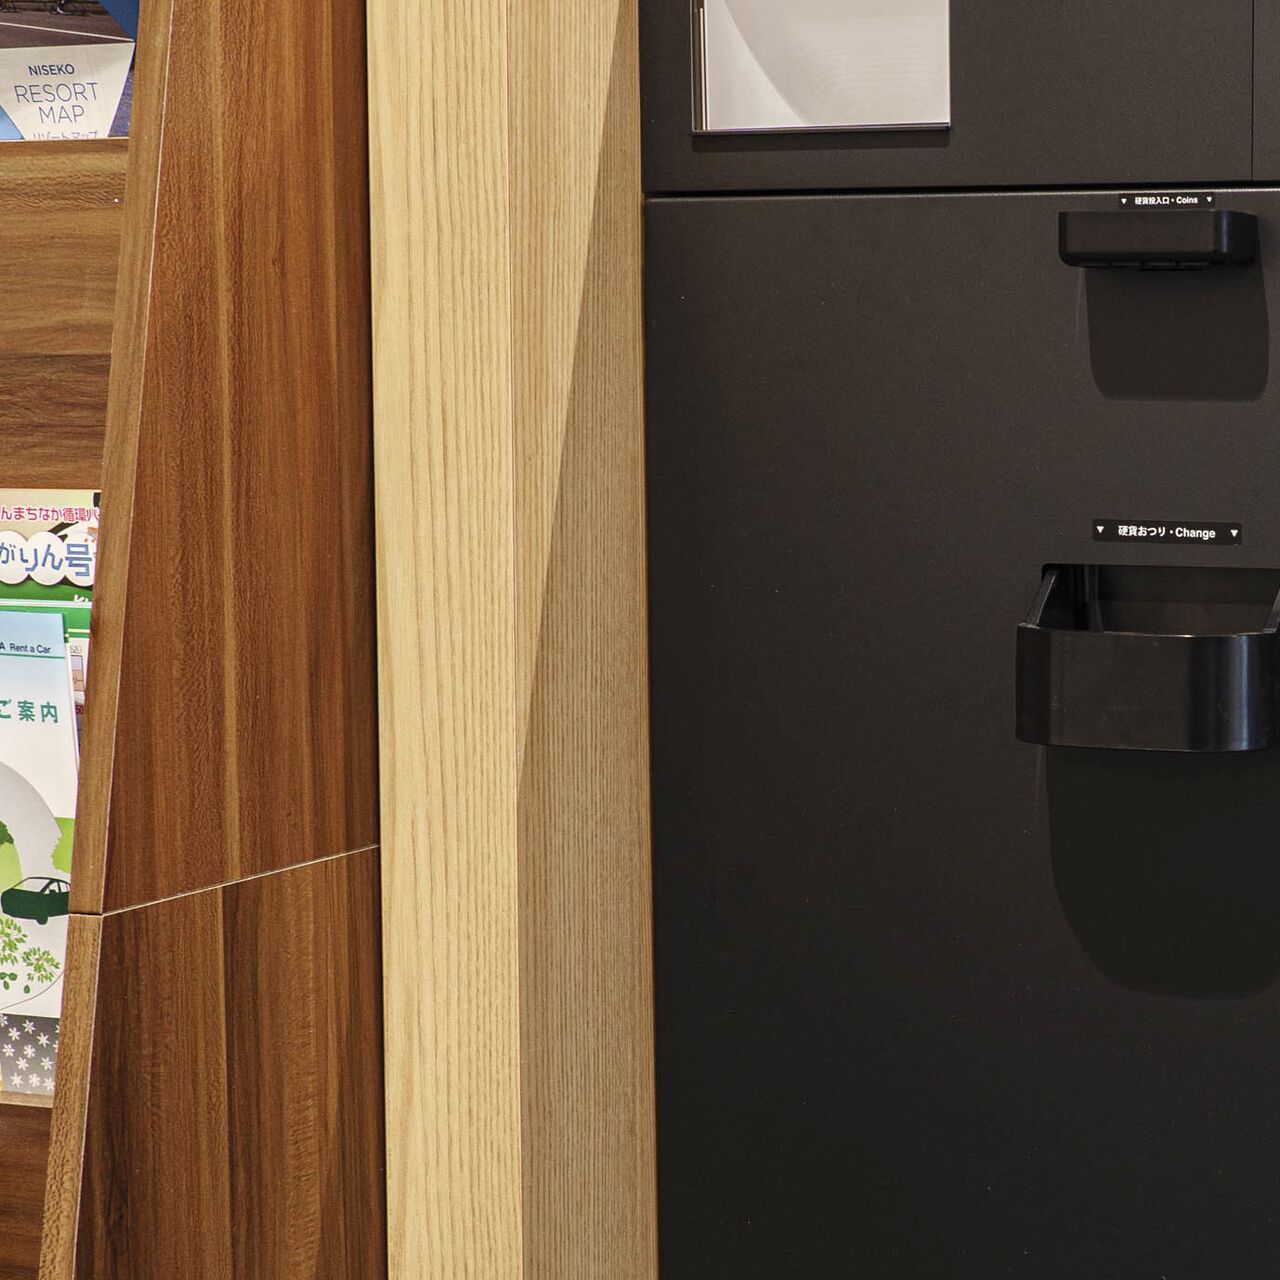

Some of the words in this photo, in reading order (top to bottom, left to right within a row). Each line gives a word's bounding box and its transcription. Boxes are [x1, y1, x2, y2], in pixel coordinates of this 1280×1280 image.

[28, 63, 75, 76] NISEKO
[14, 82, 98, 103] RESORT
[38, 105, 85, 124] MAP
[1118, 525, 1216, 540] 硬貨おつり・Change
[10, 643, 29, 653] Rent
[36, 644, 51, 654] Car
